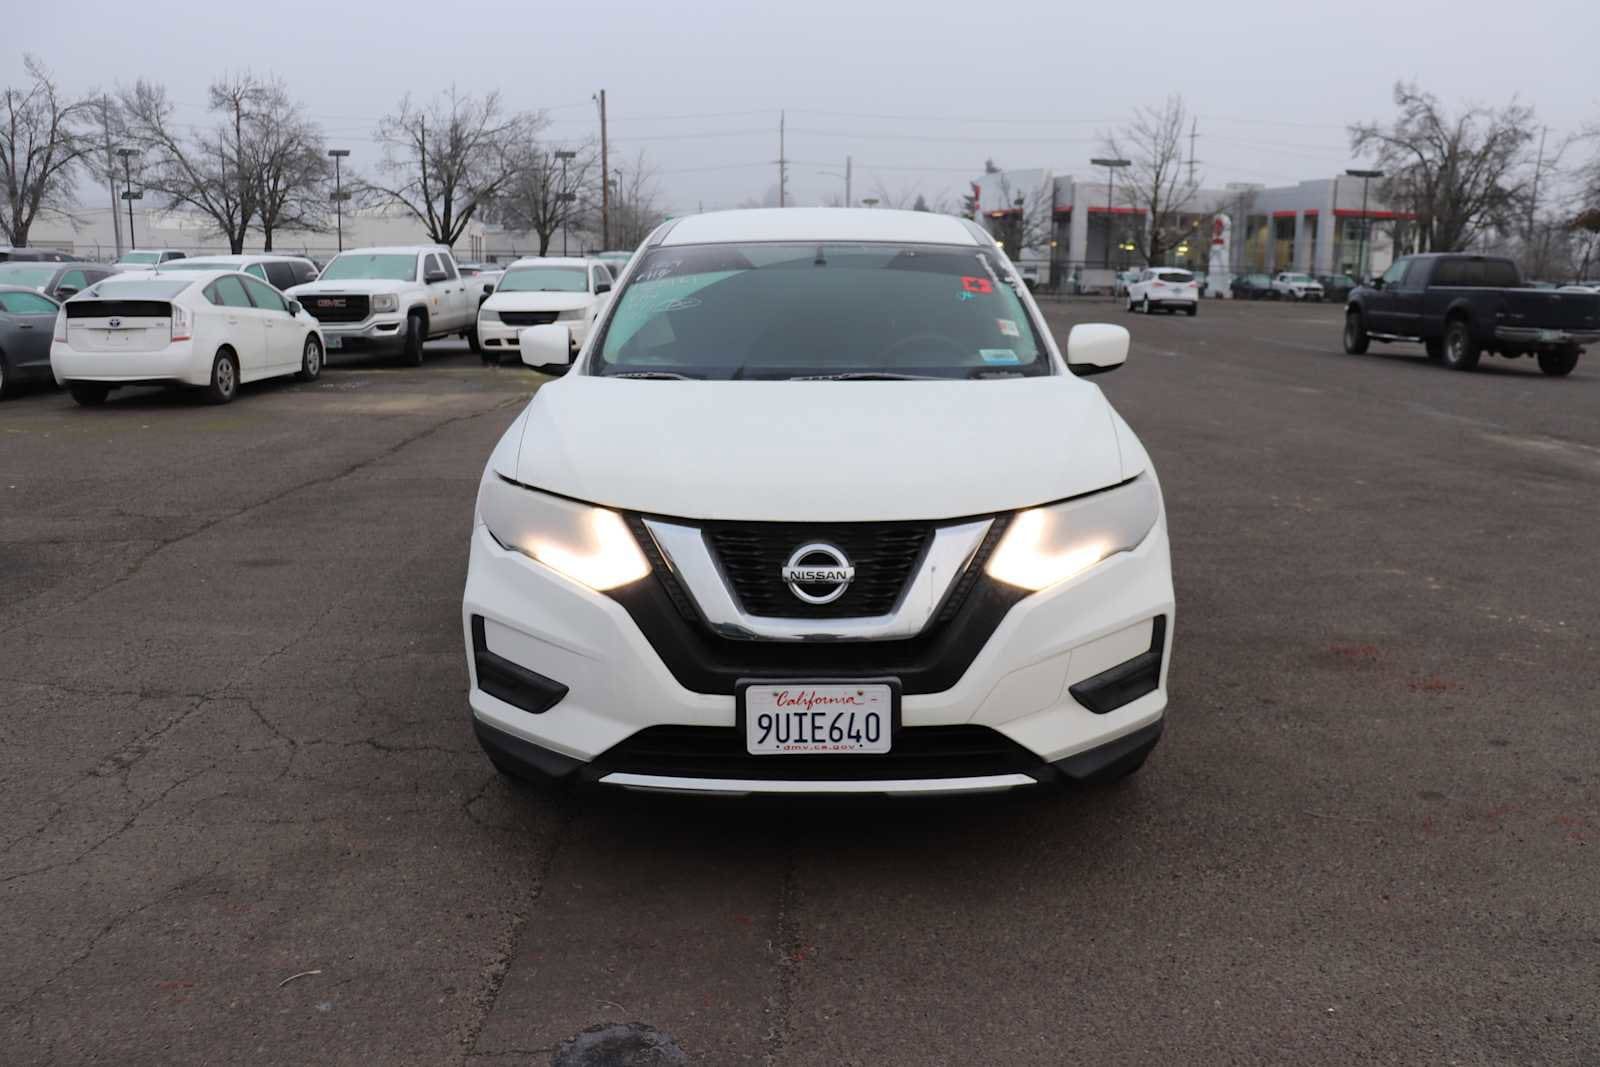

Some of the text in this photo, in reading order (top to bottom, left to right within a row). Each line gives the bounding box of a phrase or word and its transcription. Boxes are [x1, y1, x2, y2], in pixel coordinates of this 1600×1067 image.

[318, 299, 347, 308] GMC
[790, 571, 847, 580] NISSAN
[776, 690, 864, 711] California
[757, 712, 880, 744] 9UIE640
